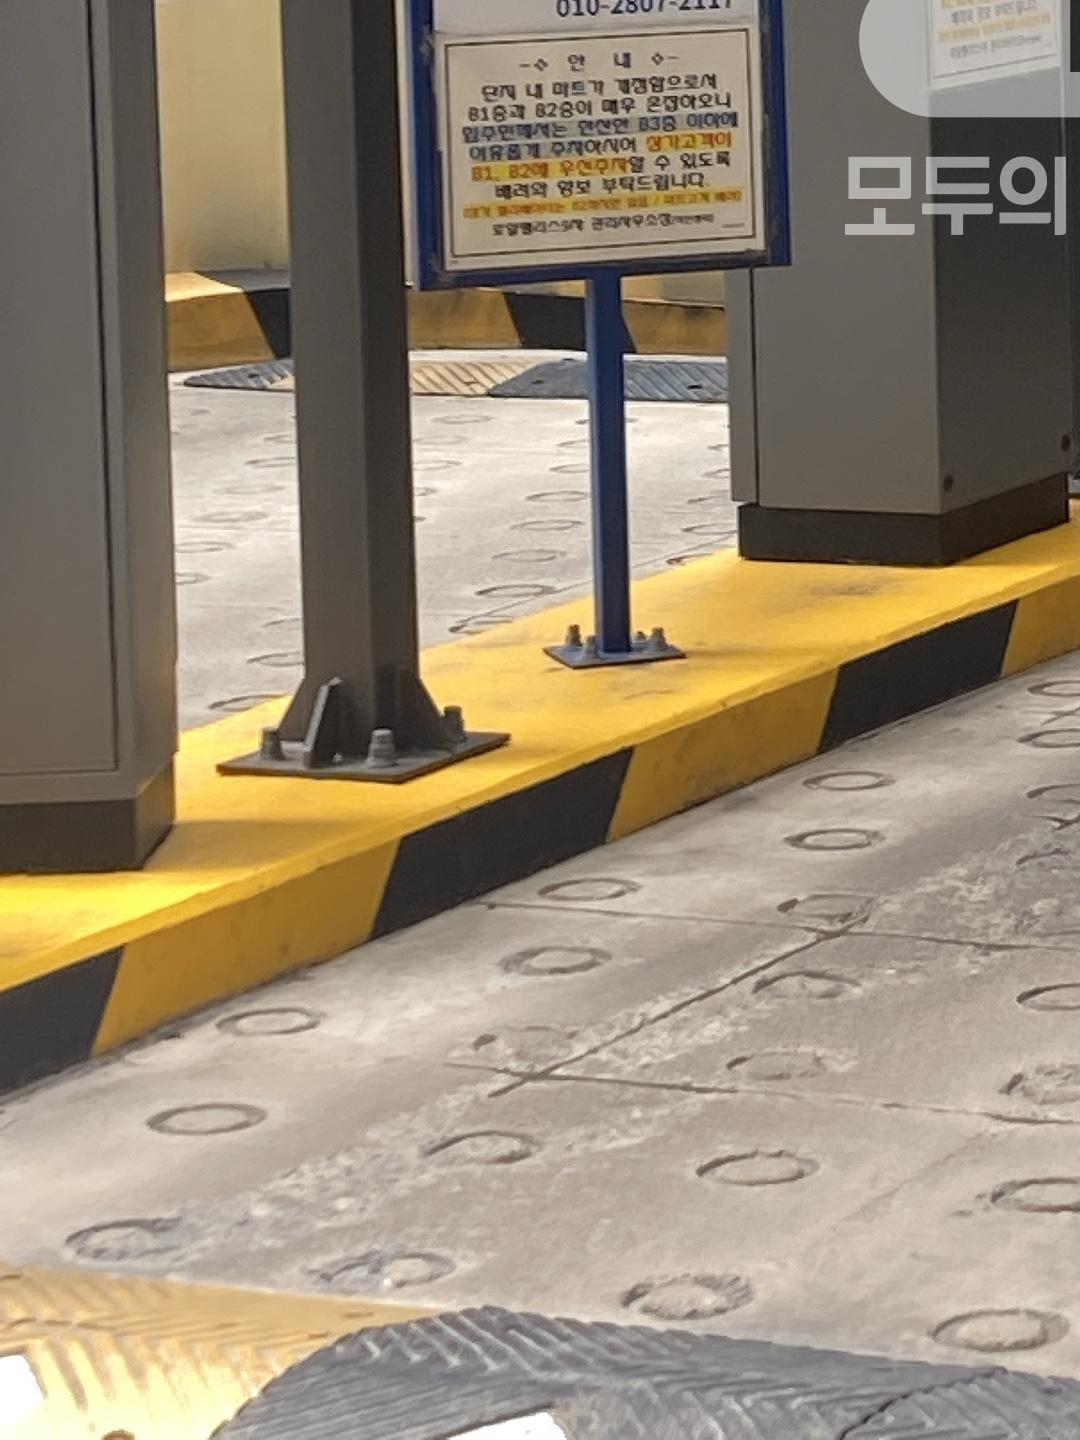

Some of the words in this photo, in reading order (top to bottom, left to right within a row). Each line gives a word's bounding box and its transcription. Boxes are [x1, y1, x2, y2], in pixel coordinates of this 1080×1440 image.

[525, 81, 544, 100] 내
[601, 96, 636, 115] 매우
[654, 153, 672, 172] 수
